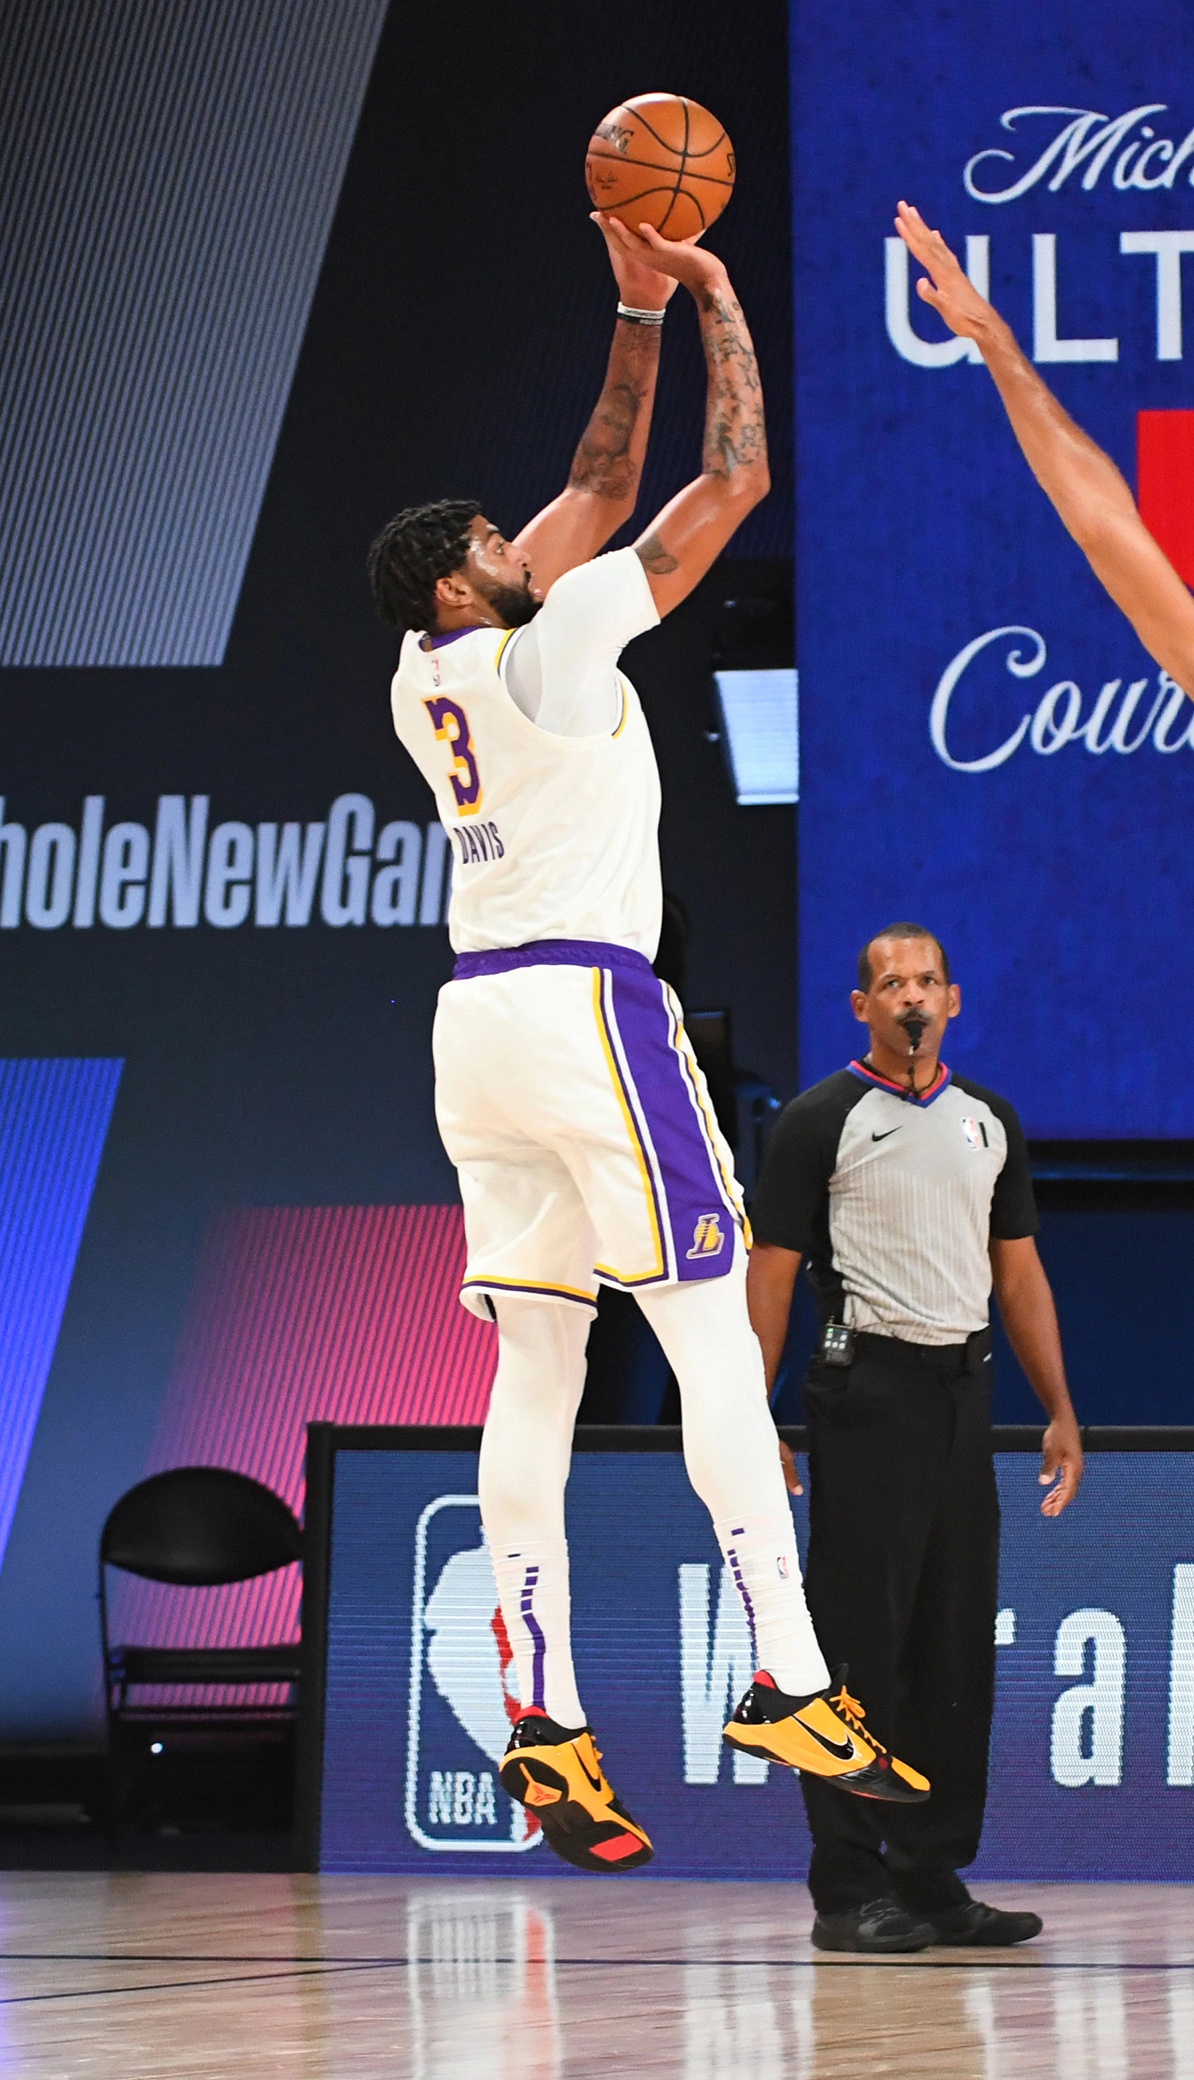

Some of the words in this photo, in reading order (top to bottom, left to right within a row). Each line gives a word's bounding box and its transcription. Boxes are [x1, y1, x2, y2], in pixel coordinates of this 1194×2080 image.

[930, 625, 1194, 773] Cour
[421, 695, 483, 816] 3
[453, 821, 505, 865] DAVIS
[428, 1770, 498, 1825] NBA
